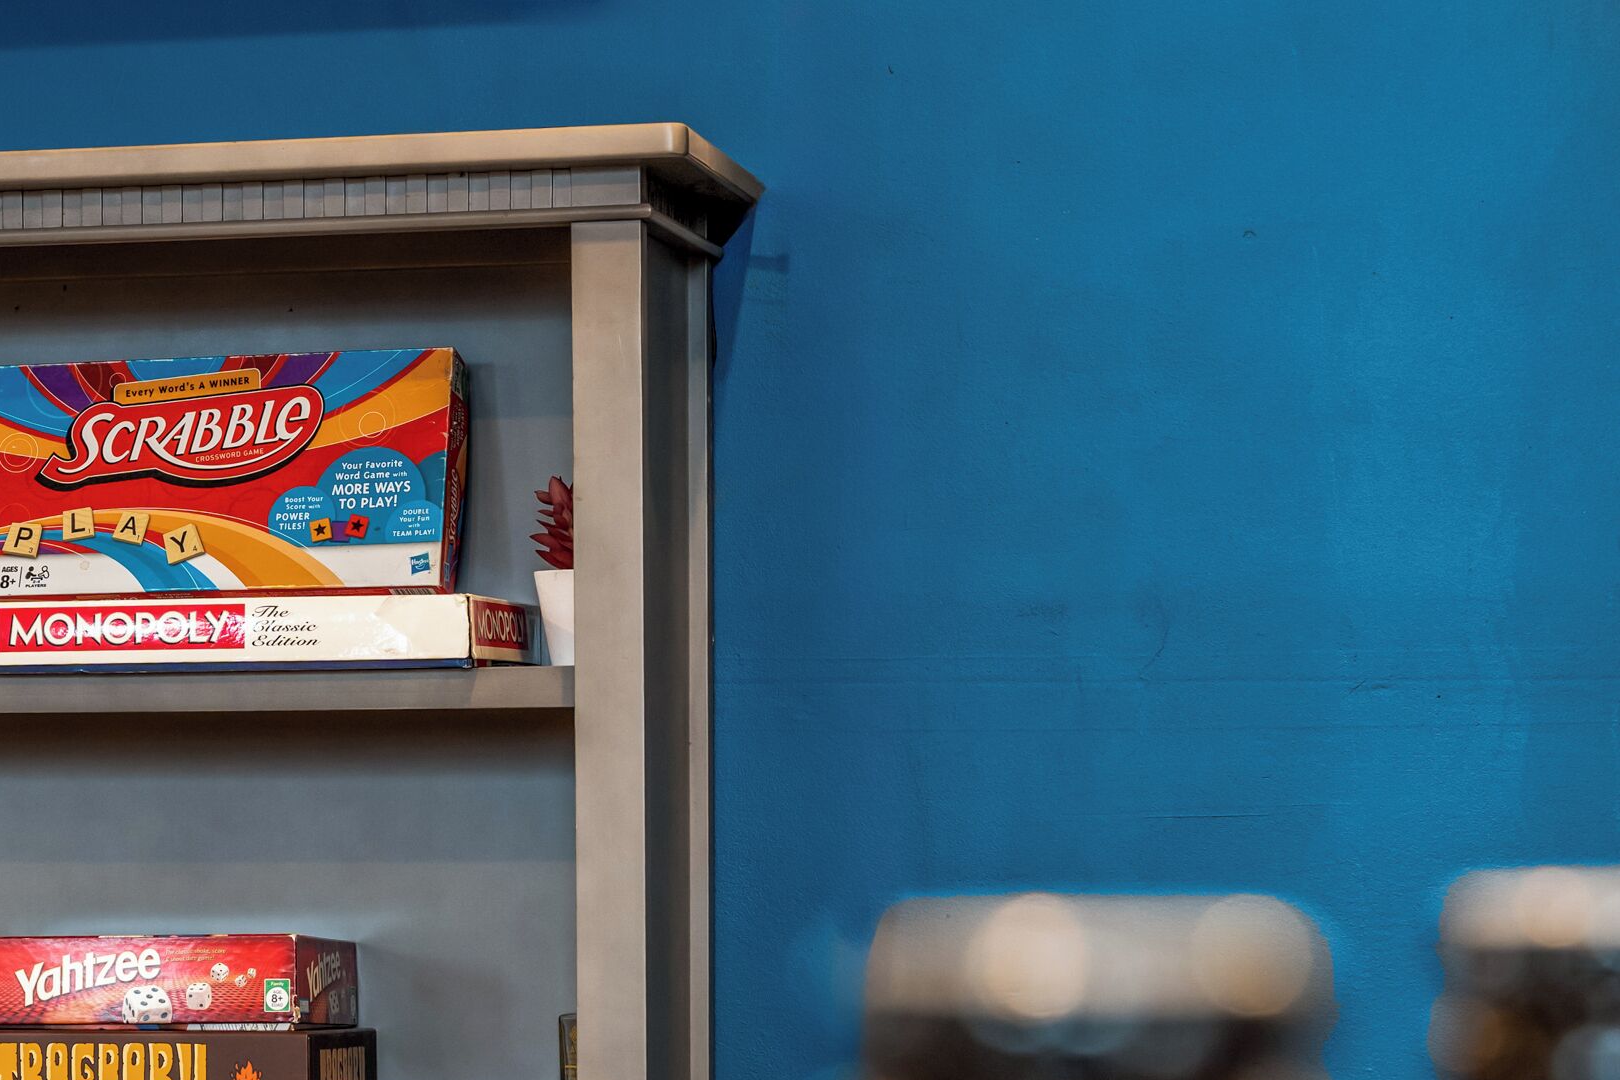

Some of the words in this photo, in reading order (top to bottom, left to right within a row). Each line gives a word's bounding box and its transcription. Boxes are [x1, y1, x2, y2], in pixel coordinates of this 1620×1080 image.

[125, 388, 155, 398] Every
[158, 383, 195, 394] Word's
[198, 381, 205, 390] A
[209, 377, 250, 388] WINNER
[195, 451, 241, 463] CROSSWORD
[243, 448, 264, 456] GAME
[342, 462, 363, 470] Your
[365, 459, 403, 469] Favorite
[335, 471, 361, 481] Word
[363, 471, 390, 479] Game
[331, 482, 370, 496] MORE
[374, 480, 411, 494] WAYS
[339, 497, 356, 510] TO
[360, 494, 398, 508] PLAY!
[275, 513, 310, 521] POWER
[279, 521, 306, 530] TILES!
[414, 528, 435, 536] PLAY!
[0, 575, 16, 589] 8+
[252, 605, 289, 618] The
[9, 610, 230, 647] MONOPOLY
[251, 634, 321, 647] Edition
[15, 948, 161, 1007] Yahtzee
[307, 951, 341, 1003] Yahtzee
[271, 994, 283, 1003] 8+
